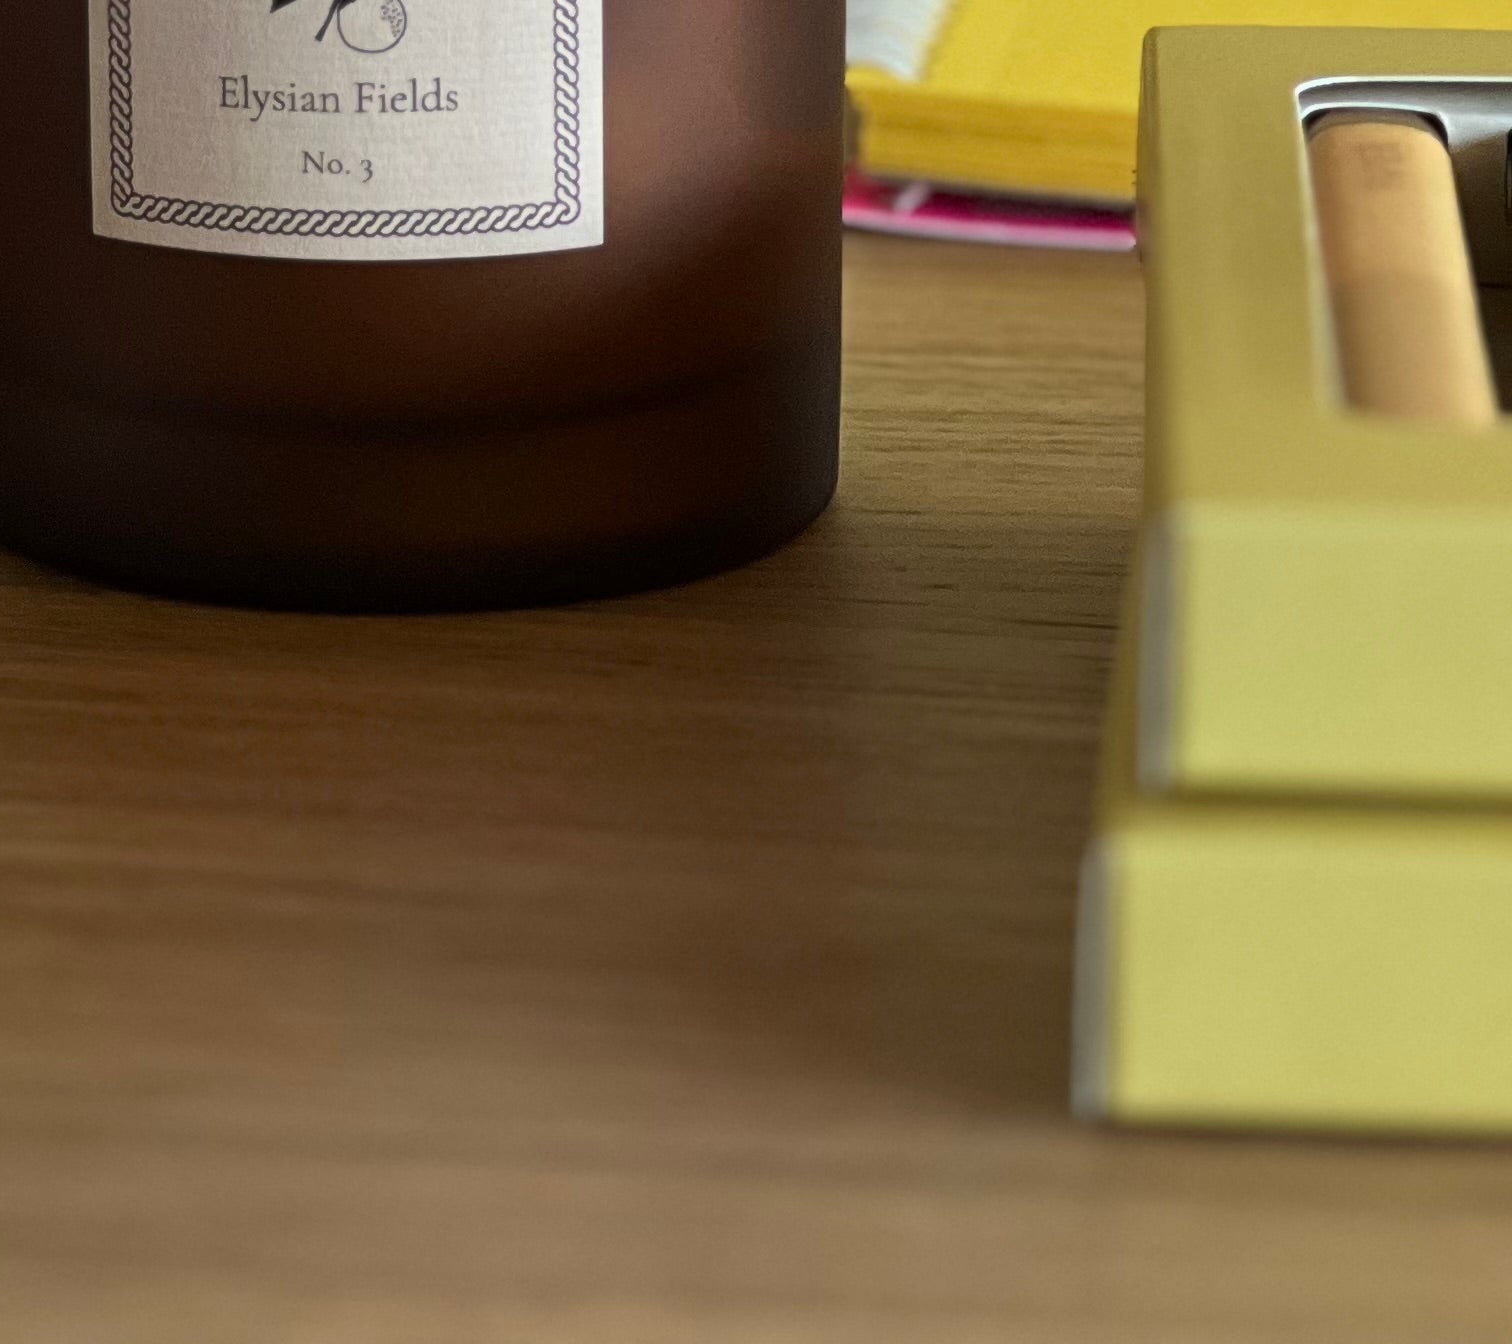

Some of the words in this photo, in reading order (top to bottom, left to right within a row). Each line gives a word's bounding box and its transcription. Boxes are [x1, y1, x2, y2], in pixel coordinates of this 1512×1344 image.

[219, 75, 340, 122] Elysian
[355, 77, 459, 113] Fields
[302, 151, 351, 175] No.
[360, 159, 373, 183] 3
